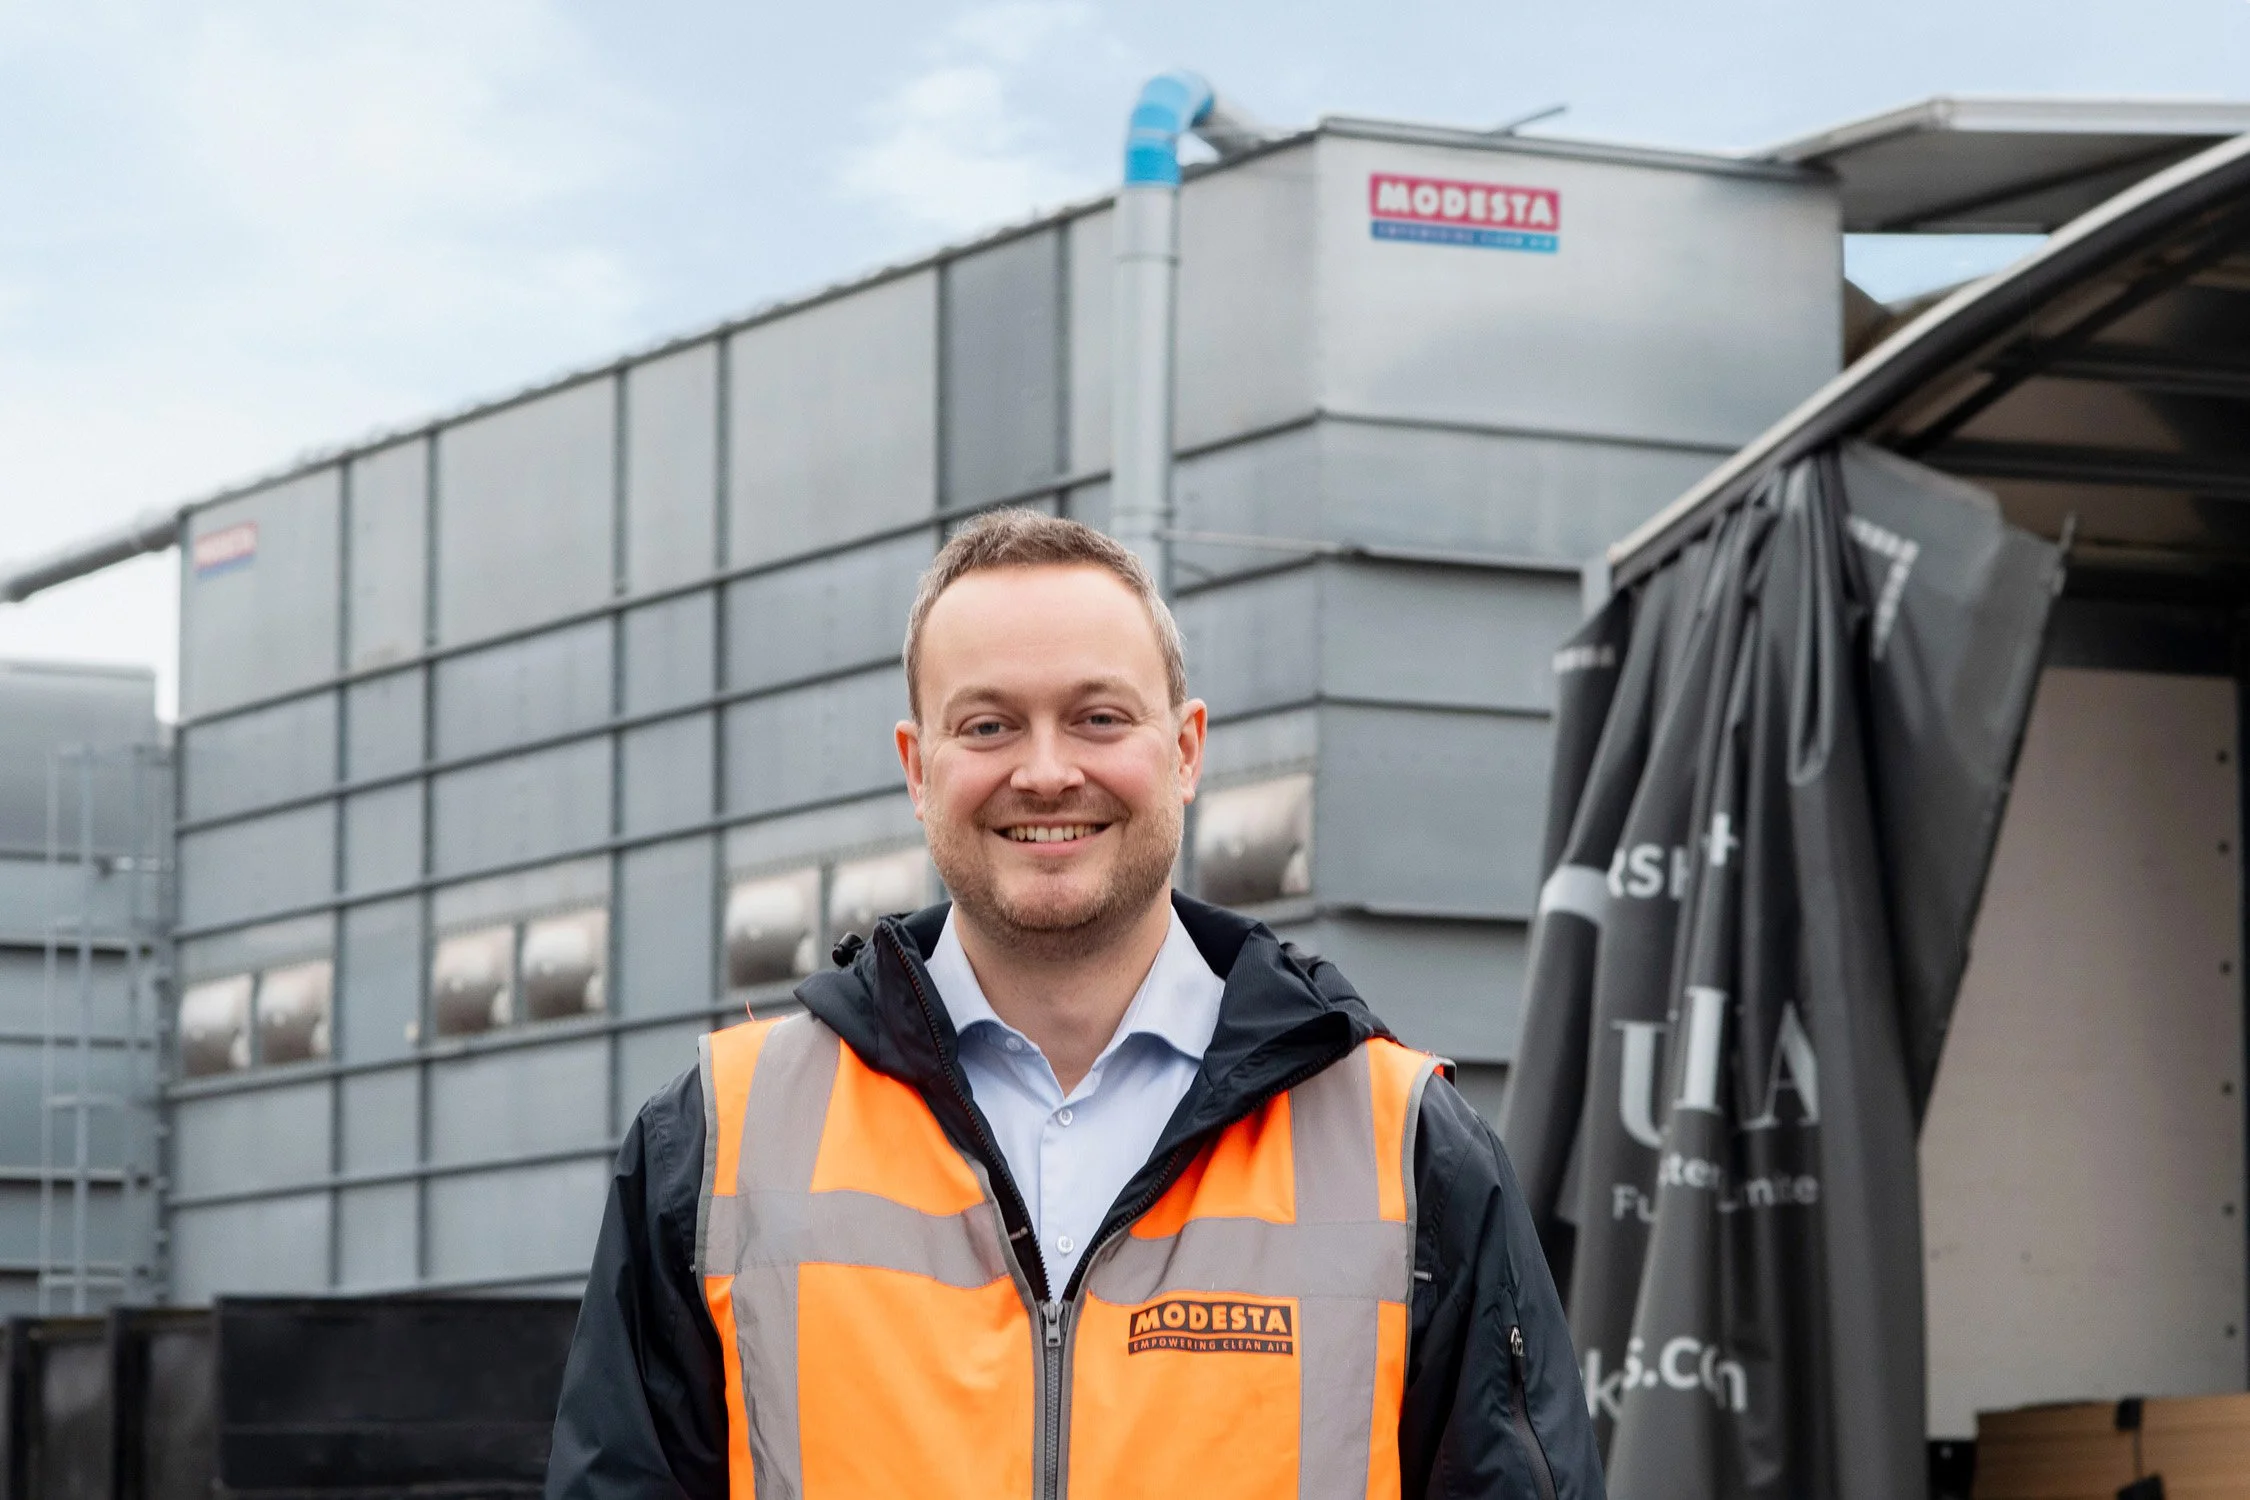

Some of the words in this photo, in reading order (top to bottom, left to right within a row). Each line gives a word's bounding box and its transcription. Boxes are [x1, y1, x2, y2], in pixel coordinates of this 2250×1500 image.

[1377, 180, 1554, 226] MODESTA
[1134, 1302, 1288, 1335] MODESTA
[1133, 1336, 1216, 1352] EMPOWERING
[1223, 1339, 1262, 1351] CLEAN
[1267, 1342, 1288, 1352] AIR
